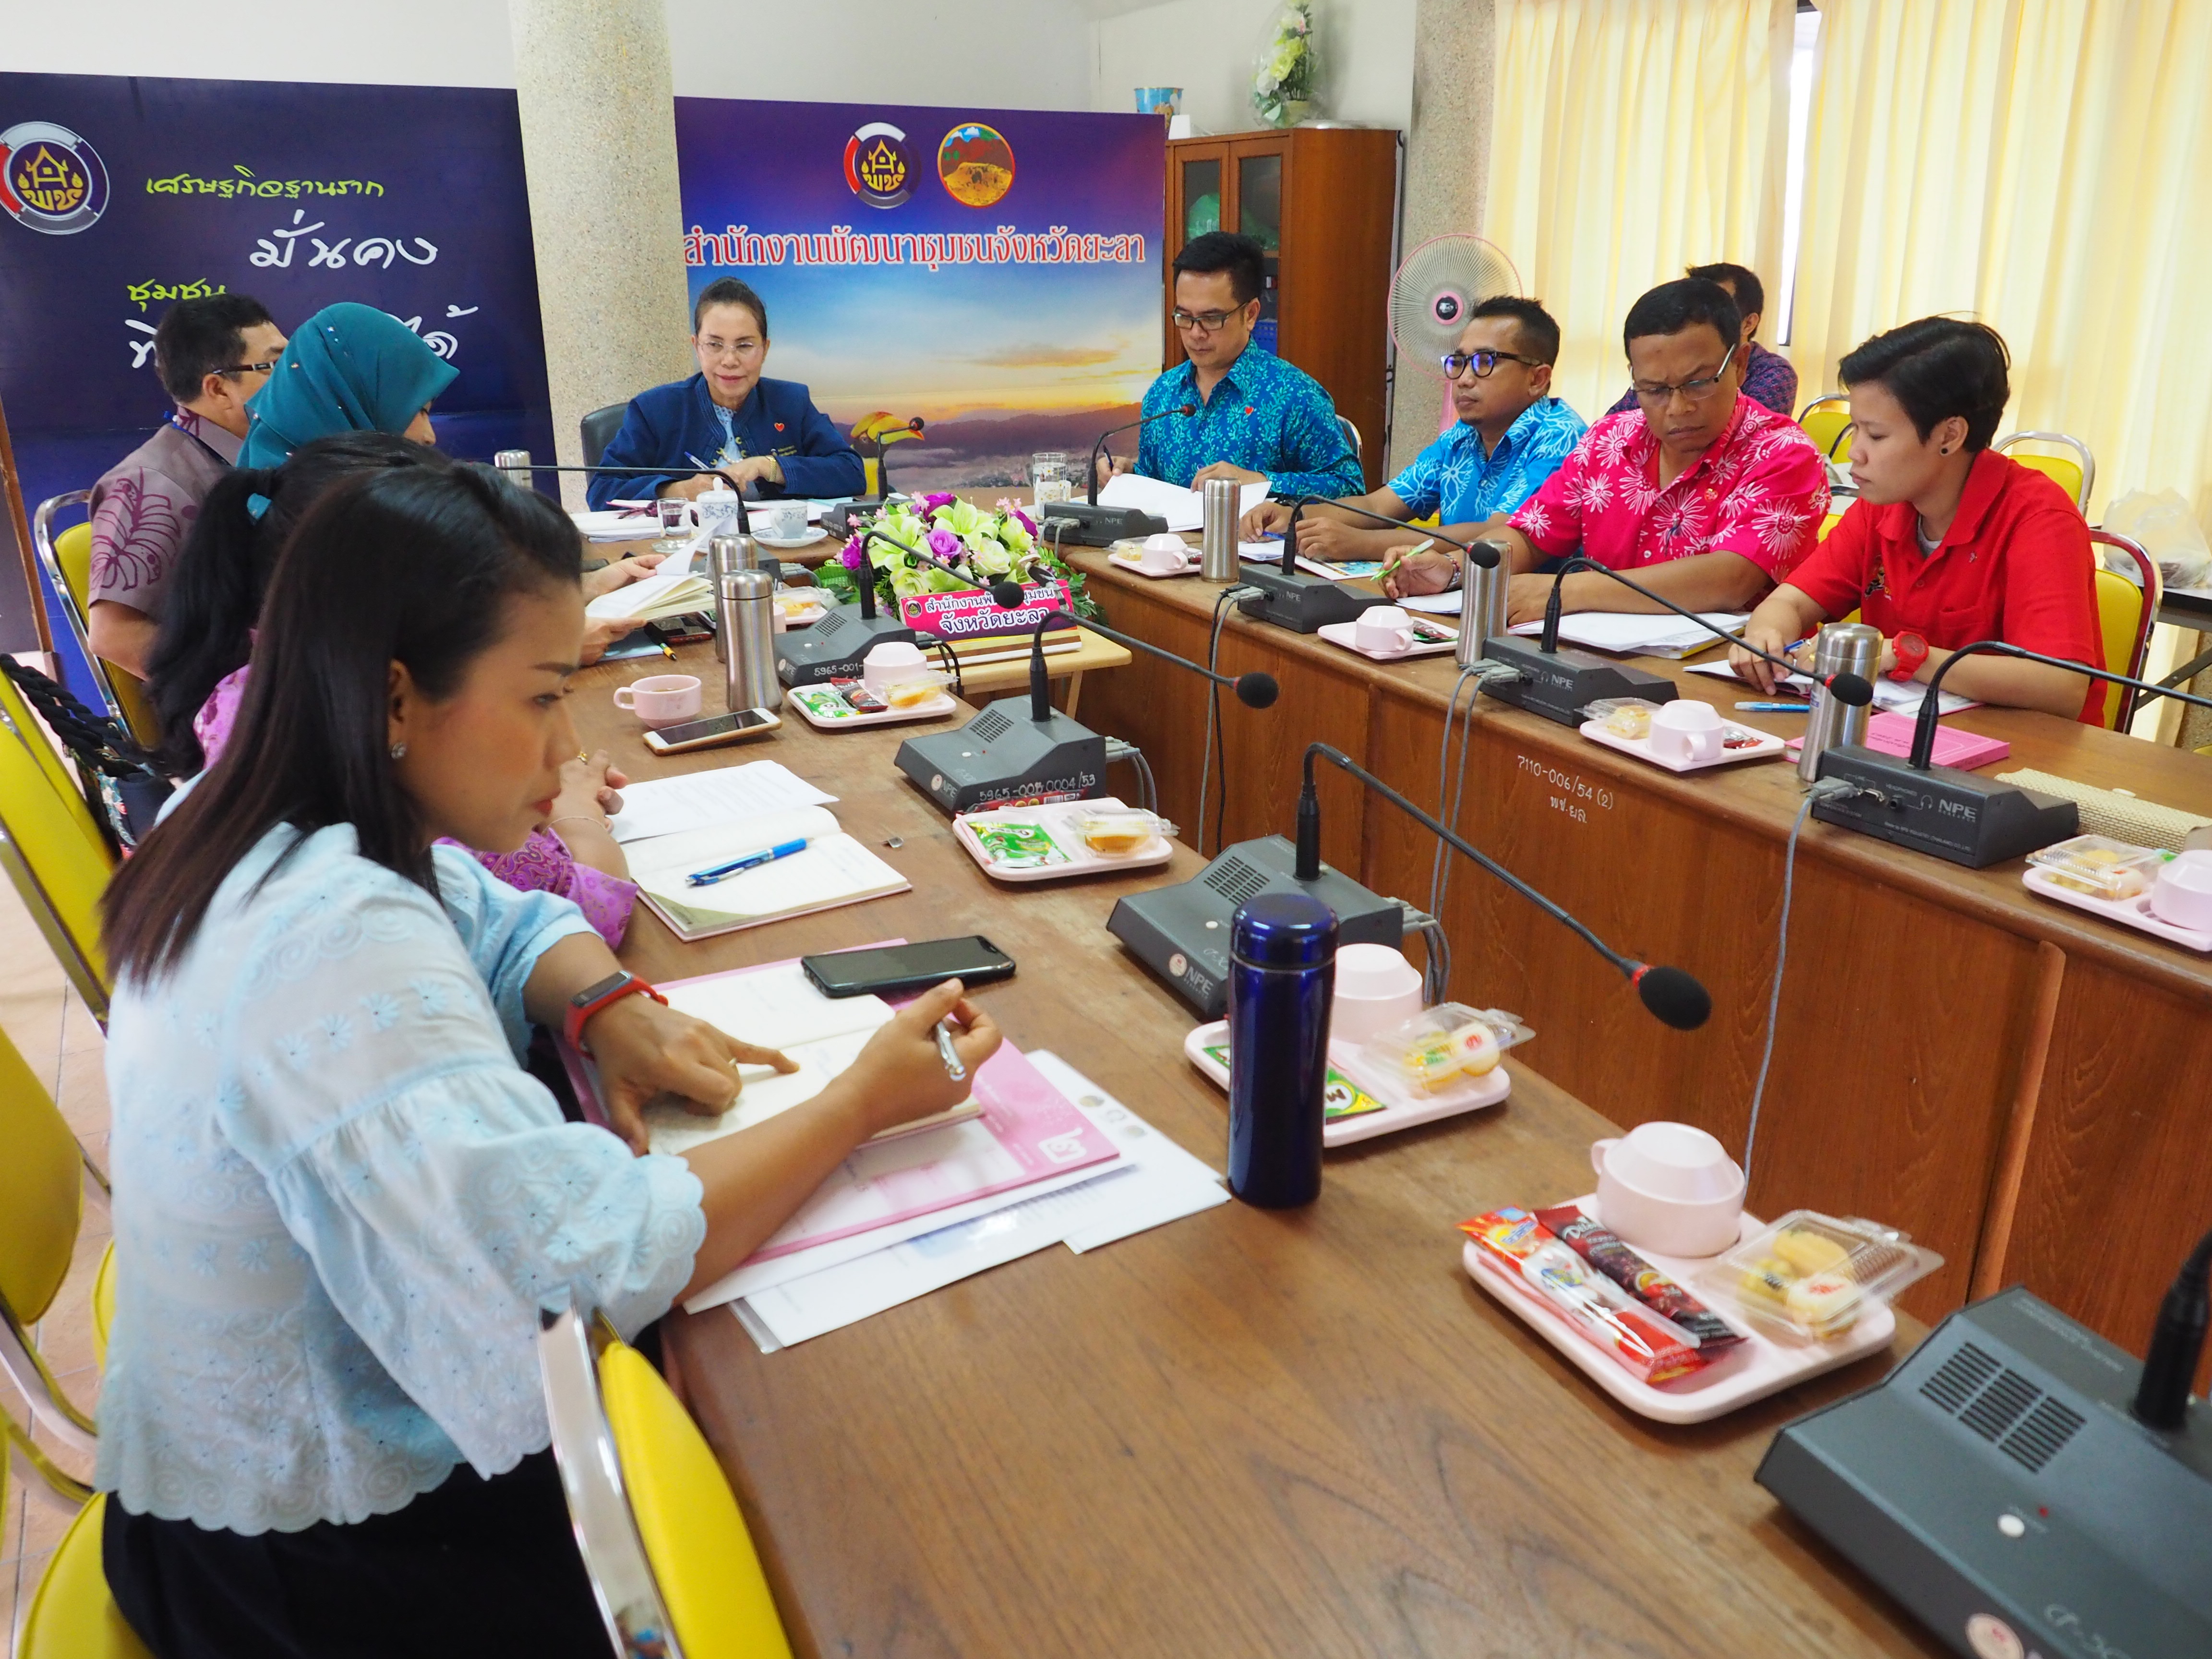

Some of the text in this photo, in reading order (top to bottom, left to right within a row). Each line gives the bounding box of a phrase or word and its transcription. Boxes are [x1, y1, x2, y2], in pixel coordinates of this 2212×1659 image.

[146, 165, 384, 198] เศรษฐกิจฐานราก
[250, 209, 438, 268] มั่นคง
[684, 225, 1146, 271] สำนักงานพัฒนาชุมชนจังหวัดยะลา
[1286, 590, 1301, 601] NPE
[1551, 674, 1574, 689] NPE
[941, 780, 958, 799] NPE
[1517, 755, 1614, 810] 7110-006/54 (2)
[1939, 799, 1977, 818] NPE
[1186, 966, 1214, 996] NPE
